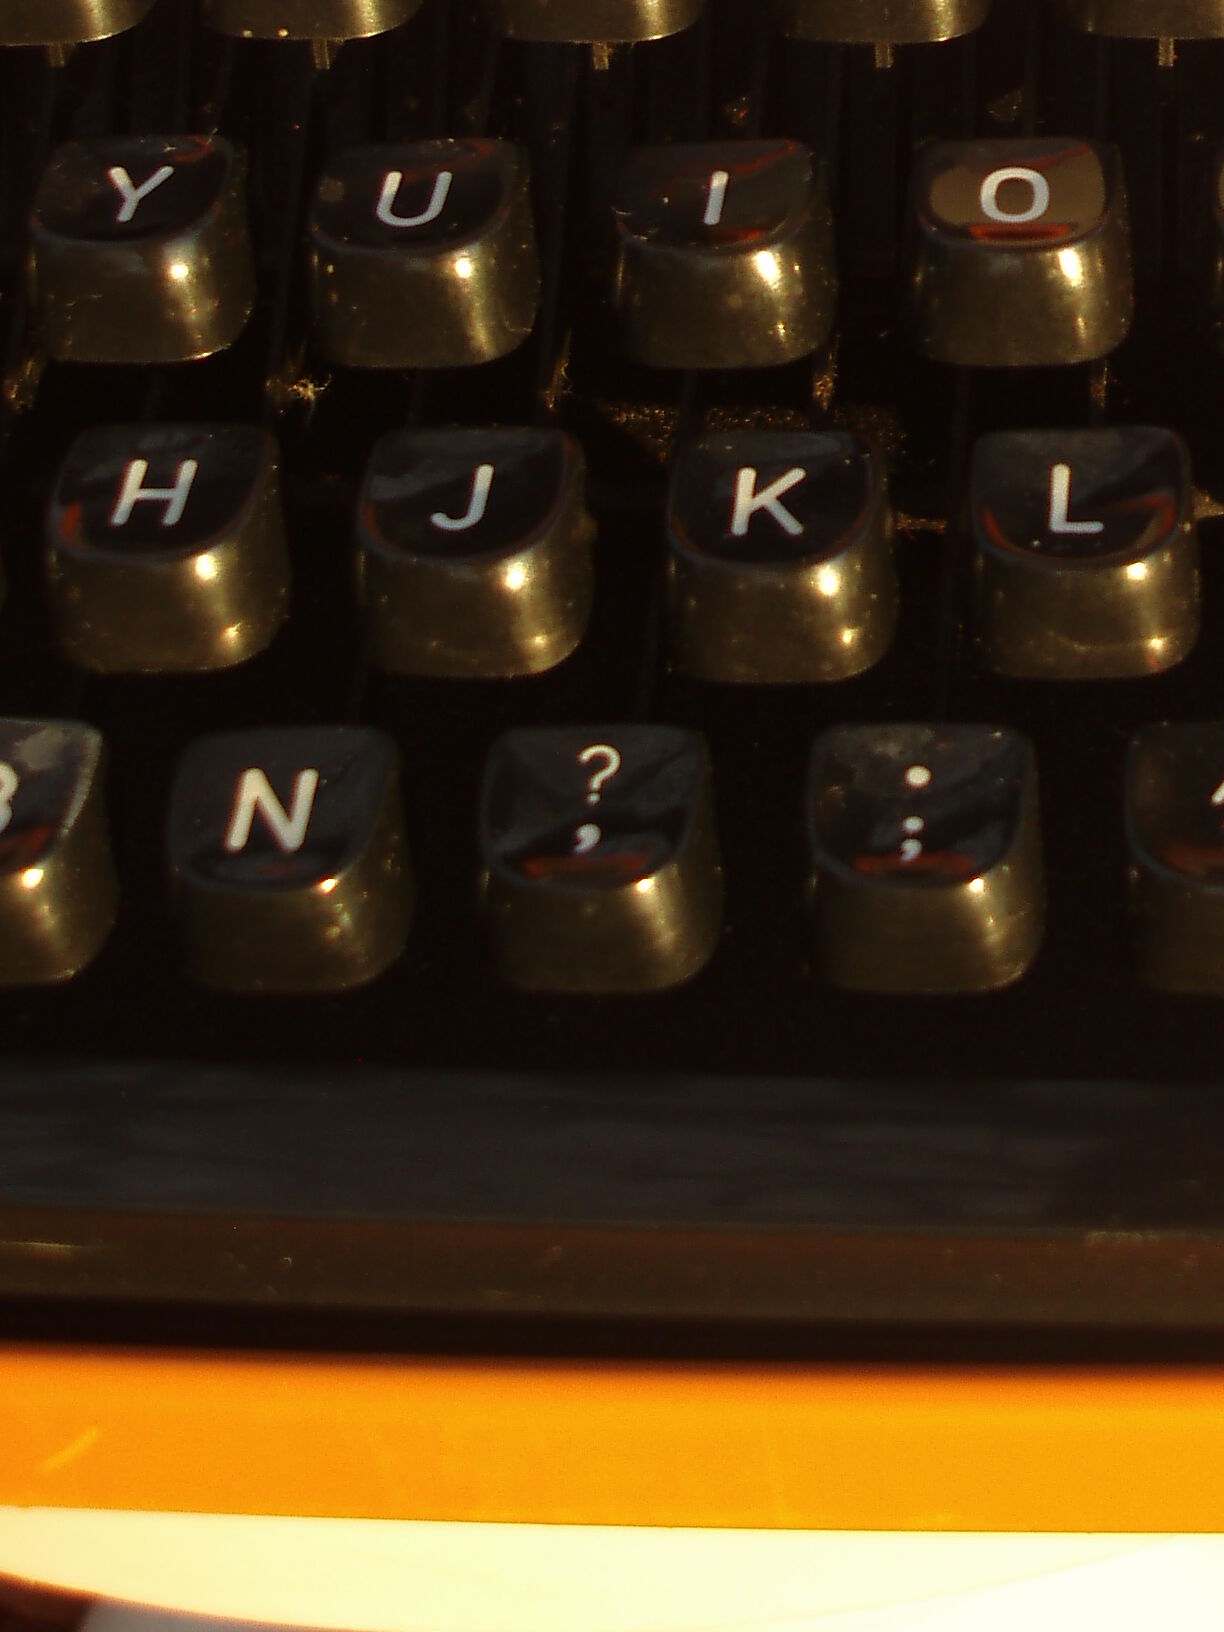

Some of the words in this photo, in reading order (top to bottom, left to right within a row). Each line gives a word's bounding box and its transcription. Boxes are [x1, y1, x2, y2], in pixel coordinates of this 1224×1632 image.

[108, 165, 174, 222] Y
[376, 171, 452, 227] U
[703, 171, 728, 226] I
[980, 167, 1049, 224] O
[111, 459, 198, 526] H
[431, 464, 494, 531] J
[731, 467, 806, 536] K
[1049, 464, 1104, 534] L
[580, 745, 620, 804] ?
[227, 769, 318, 850] N
